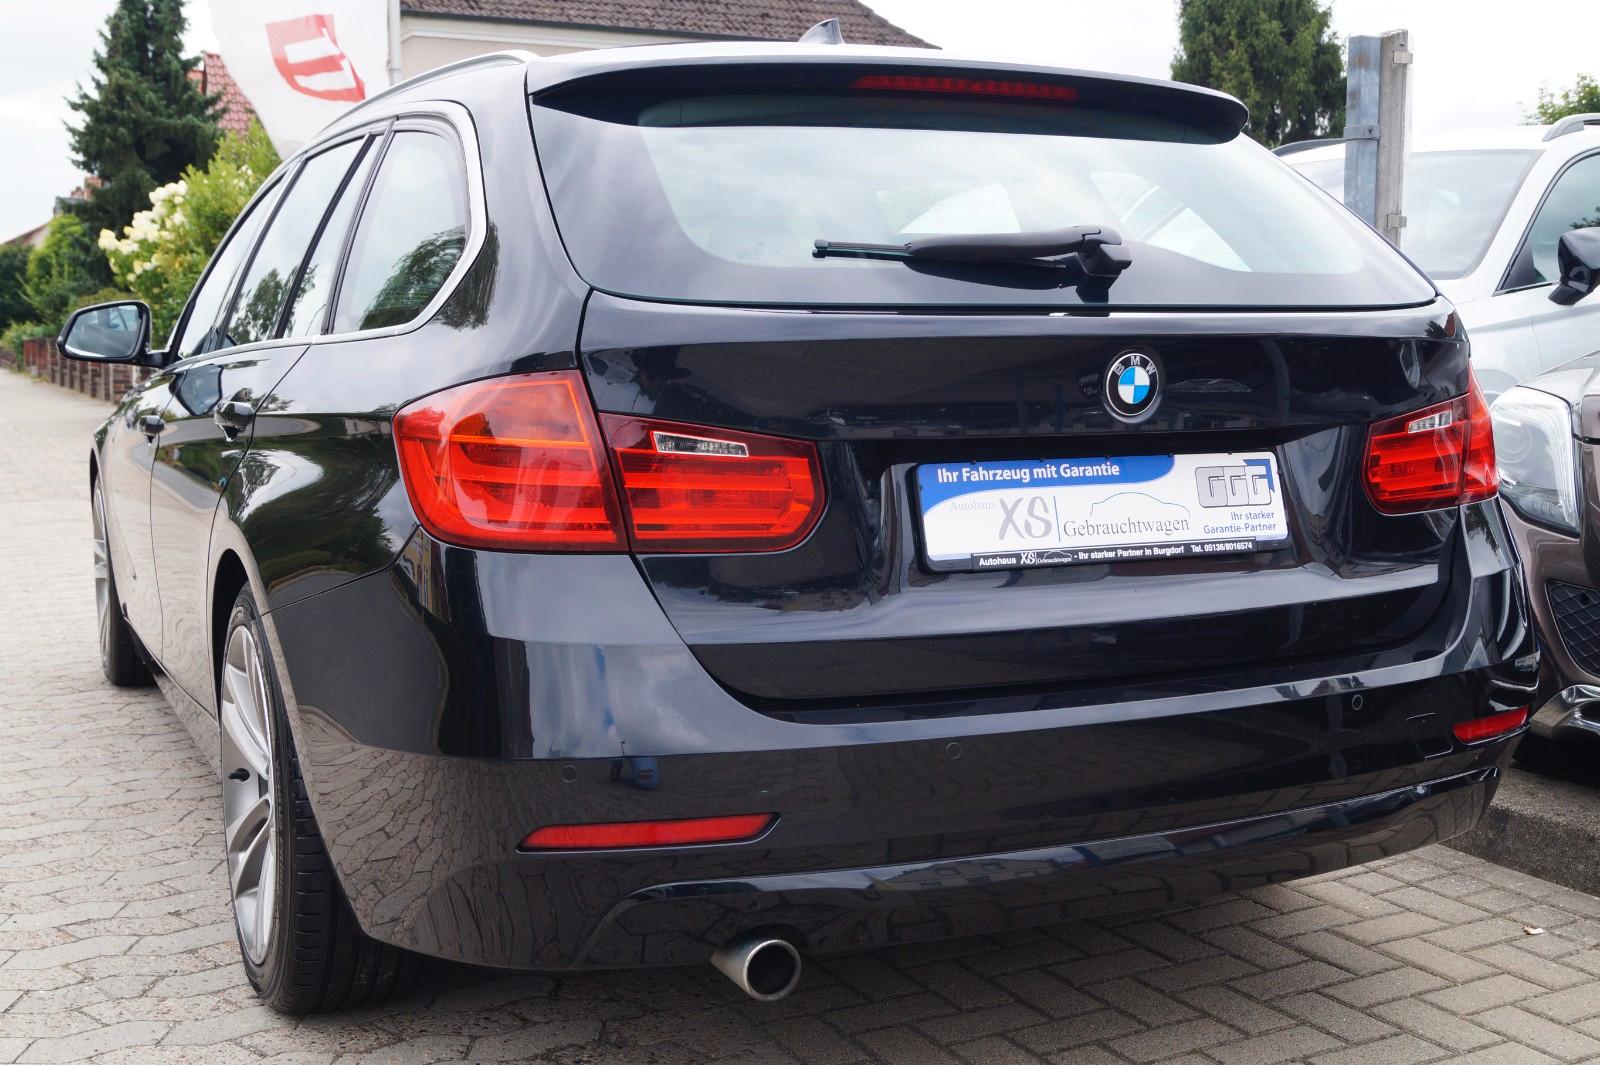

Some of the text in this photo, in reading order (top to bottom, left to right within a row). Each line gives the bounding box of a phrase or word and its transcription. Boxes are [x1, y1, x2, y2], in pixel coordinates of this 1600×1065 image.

[1113, 355, 1156, 376] BMW
[937, 462, 1120, 483] Ihr Fahrzeug mit Garantie
[998, 496, 1053, 541] XS
[1231, 511, 1275, 521] Ihr starker
[1063, 517, 1190, 537] Gebrauchtwagen
[1203, 522, 1277, 534] Garantie-Partner
[978, 557, 1017, 567] Autohaus
[1020, 551, 1035, 565] XS
[1078, 552, 1089, 560] Ihr
[1090, 550, 1116, 559] starker
[1117, 548, 1144, 557] Partner
[1144, 547, 1152, 556] in
[1153, 546, 1185, 556] Burgdorf
